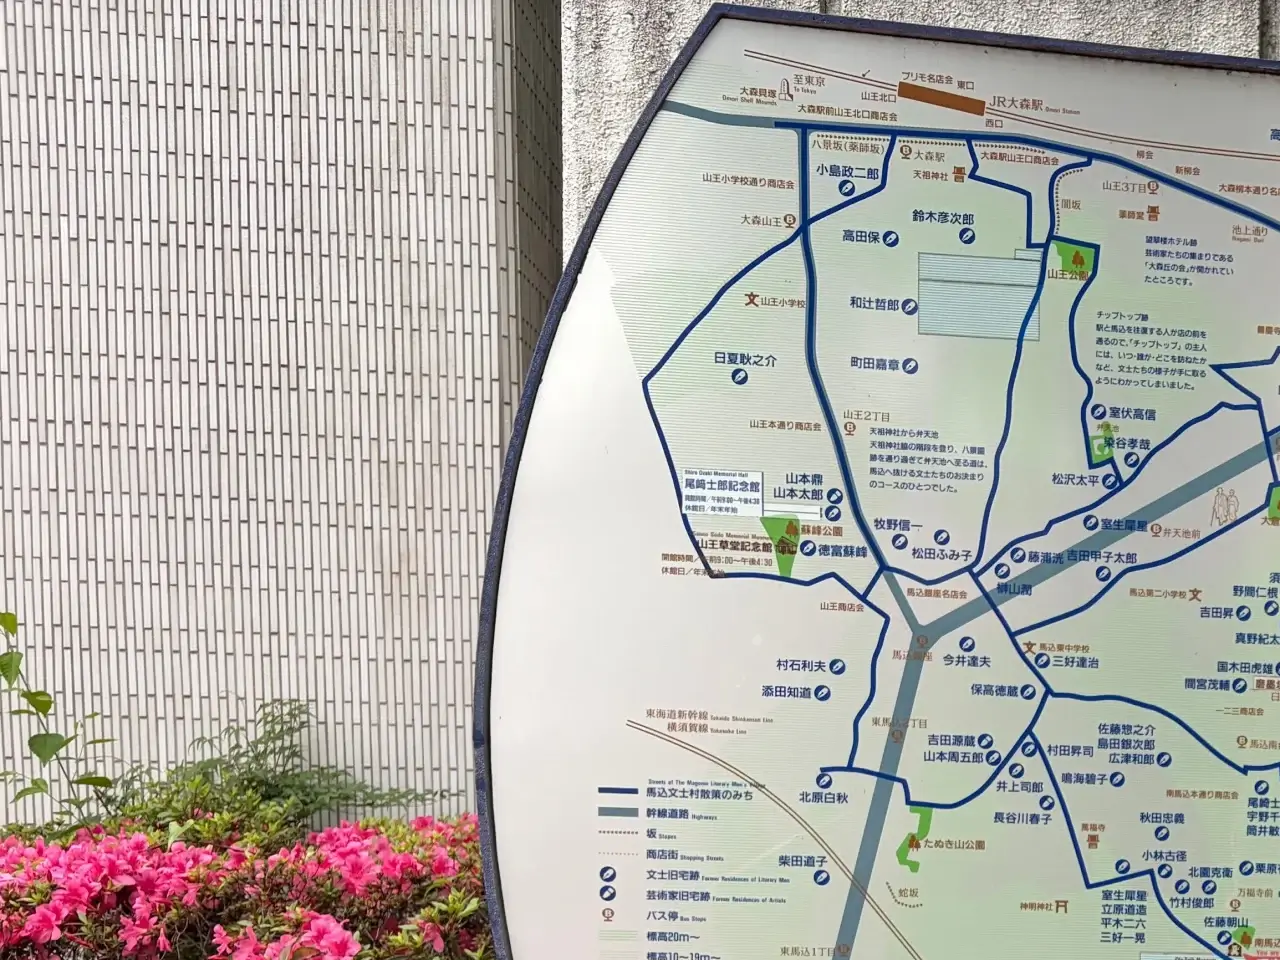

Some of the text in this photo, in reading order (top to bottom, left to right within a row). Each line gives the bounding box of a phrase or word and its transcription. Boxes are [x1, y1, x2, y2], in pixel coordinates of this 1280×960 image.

[793, 75, 825, 87] 至東京
[957, 80, 974, 90] 東口
[861, 91, 896, 102] 山王北口
[989, 95, 1043, 112] JR大森駅
[798, 104, 898, 121] 大森駅前山王北口商店会
[985, 119, 1003, 128] 西口
[914, 151, 944, 162] 大森駅
[817, 164, 879, 180] 小島政二郎
[1102, 181, 1146, 192] 山王3丁目
[741, 215, 782, 227] 大森山王
[912, 210, 974, 225] 鈴木彦次郎
[842, 229, 880, 243] 高田保
[1048, 269, 1088, 281] 山王公園
[1144, 276, 1194, 287] たところです。
[761, 297, 805, 308] 山王小学校
[850, 297, 899, 312] 和辻哲郎
[714, 352, 777, 368] 日夏耿之介
[851, 357, 899, 371] 町田嘉章
[843, 410, 890, 422] 山王2丁目
[1109, 407, 1156, 421] 室伏高信
[750, 419, 821, 431] 山王本通り商店会
[870, 428, 938, 438] 天祖神社から弁天池
[786, 472, 823, 485] 山本鼎
[1052, 473, 1099, 486] 松沢太平
[773, 487, 823, 500] 山本太郎
[870, 481, 958, 493] のコースのひとつでした。
[874, 518, 922, 531] 牧野信一
[699, 539, 772, 553] 山王草堂記念館
[818, 544, 868, 558] 徳富蘇峰
[912, 548, 972, 561] 松田ふみ子
[1130, 588, 1186, 599] 馬込第二小学校
[1232, 585, 1278, 599] 野間仁根
[1200, 606, 1233, 619] 吉田昇
[1039, 643, 1089, 654] 馬込東中学校
[776, 659, 826, 672] 村石利夫
[943, 655, 991, 668] 今井達夫
[1052, 656, 1099, 669] 三好達治
[1217, 662, 1273, 675] 国木田虎雄
[971, 684, 1018, 698] 保高徳蔵
[1185, 678, 1230, 691] 間宮茂輔
[762, 686, 811, 699] 添田知道
[646, 708, 708, 721] 東海道新幹線
[667, 722, 708, 734] 横須賀線
[1098, 723, 1156, 736] 佐藤惣之介
[928, 734, 975, 747] 吉田源蔵
[1098, 738, 1155, 751] 島田銀次郎
[924, 751, 983, 764] 山本周五郎
[1047, 745, 1093, 758] 村田昇司
[1108, 753, 1154, 766] 広津和郎
[1062, 772, 1108, 786] 鳴海碧子
[996, 781, 1043, 793] 井上司郎
[647, 788, 753, 801] 馬込文士村散策のみち
[799, 791, 848, 804] 北原白秋
[647, 808, 689, 819] 幹線道路
[993, 812, 1052, 825] 長谷川春子
[1140, 812, 1185, 825] 秋田忠義
[647, 829, 656, 839] 坂
[923, 839, 985, 850] たぬき山公園
[647, 849, 678, 860] 商店街
[1142, 850, 1187, 862] 小林古径
[778, 855, 828, 868] 柴田道子
[647, 869, 700, 881] 文士旧宅跡
[1188, 867, 1233, 878] 北園克衛
[647, 890, 710, 901] 芸術家旧宅跡
[1101, 903, 1147, 916] 立原道造
[1169, 897, 1214, 909] 竹村俊郎
[647, 911, 678, 922] バス停
[1204, 917, 1248, 928] 佐藤朝山
[1100, 918, 1146, 930] 平木二六
